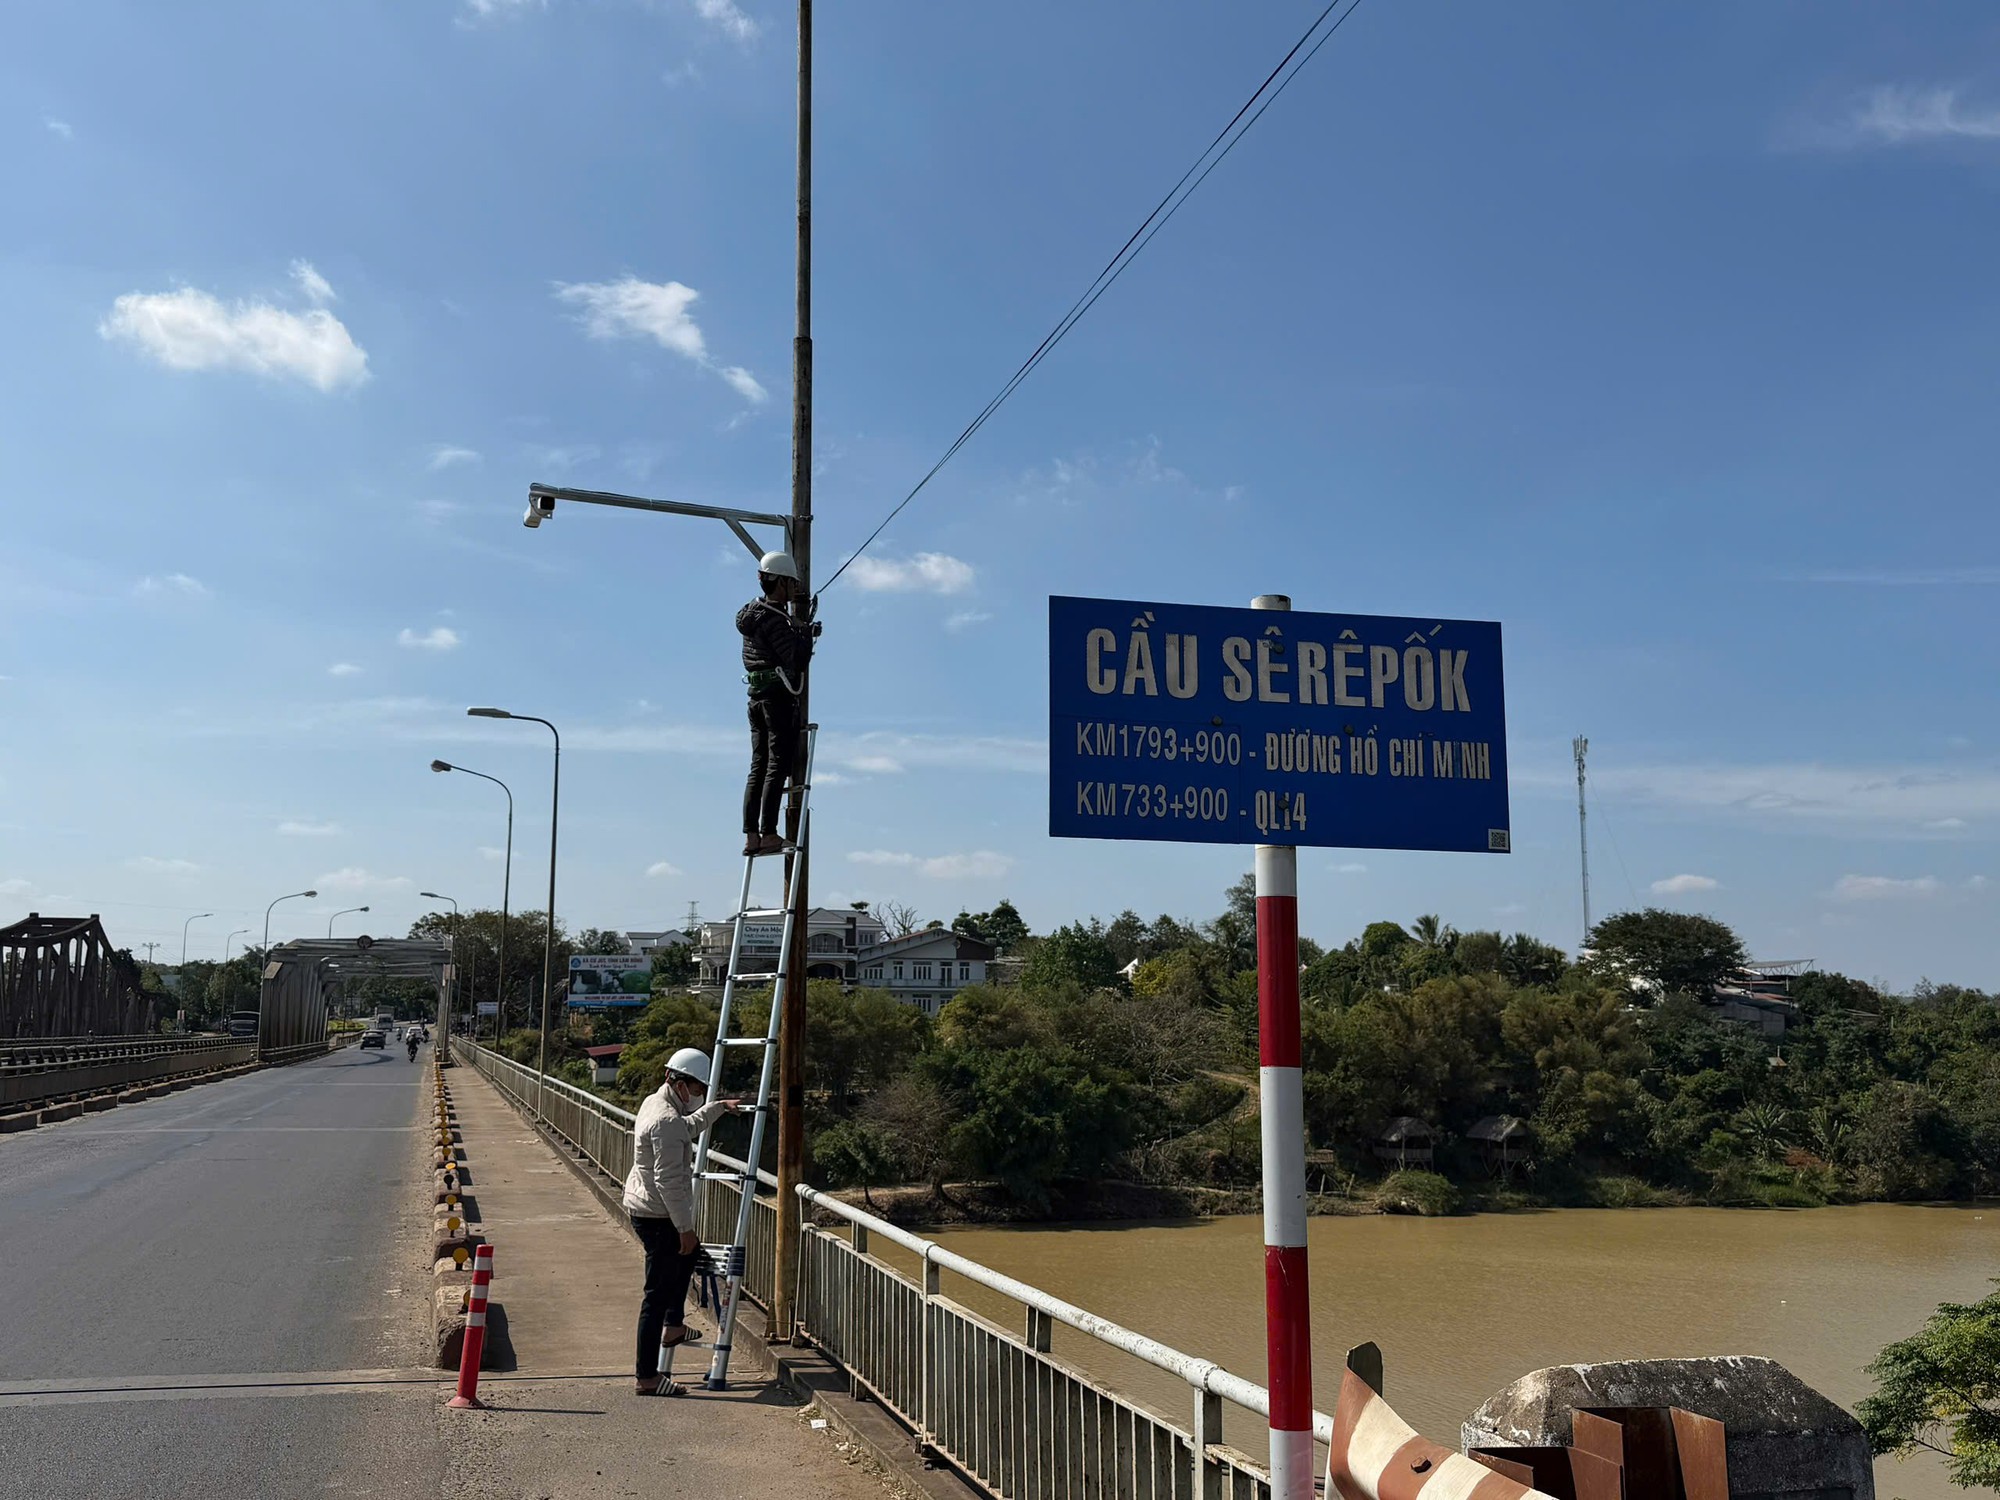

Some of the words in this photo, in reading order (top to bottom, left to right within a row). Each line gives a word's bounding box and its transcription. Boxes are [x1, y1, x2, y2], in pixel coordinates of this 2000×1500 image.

[1086, 611, 1199, 699] CẦU
[1222, 624, 1472, 712] SÊRÊPỐK
[1077, 722, 1242, 767] KM1793+900
[1350, 724, 1379, 776] HỒ
[1388, 732, 1424, 777] CHÍ
[1077, 781, 1228, 822] KM733+900
[1255, 790, 1308, 836] QL14
